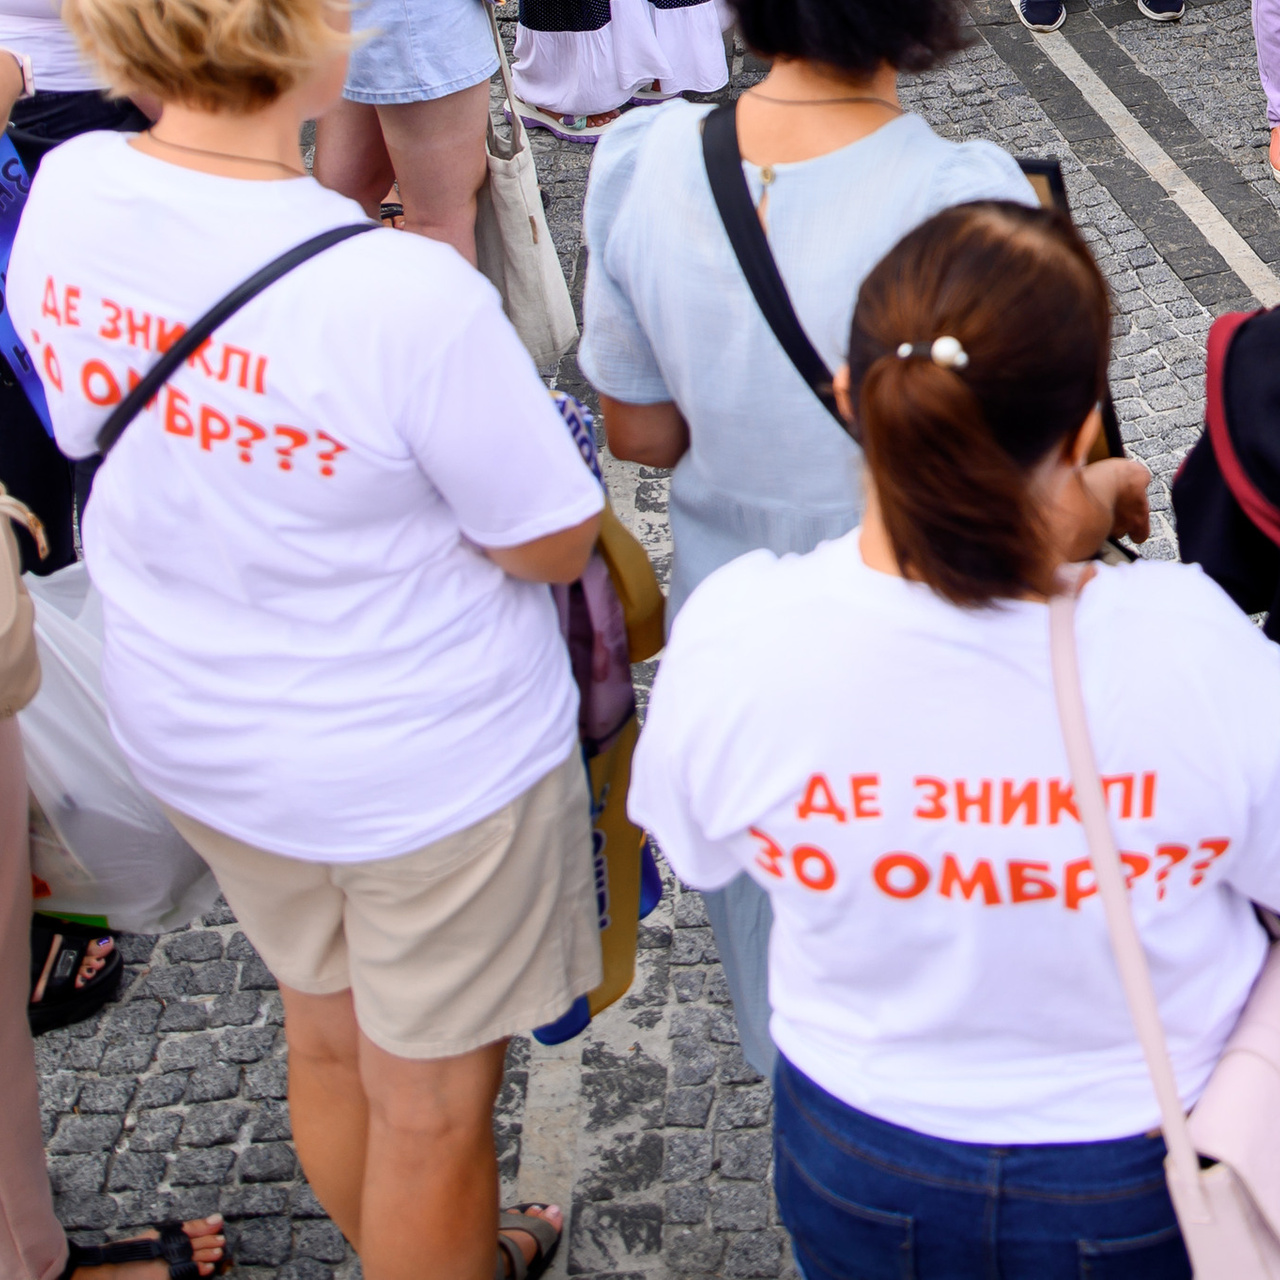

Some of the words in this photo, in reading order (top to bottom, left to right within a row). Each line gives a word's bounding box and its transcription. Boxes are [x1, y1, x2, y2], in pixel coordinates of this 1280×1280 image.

[41, 274, 81, 327] ДЕ
[796, 771, 881, 824] ДЕ
[914, 771, 1157, 826] ЗНИКЛІ
[748, 826, 837, 891] 30
